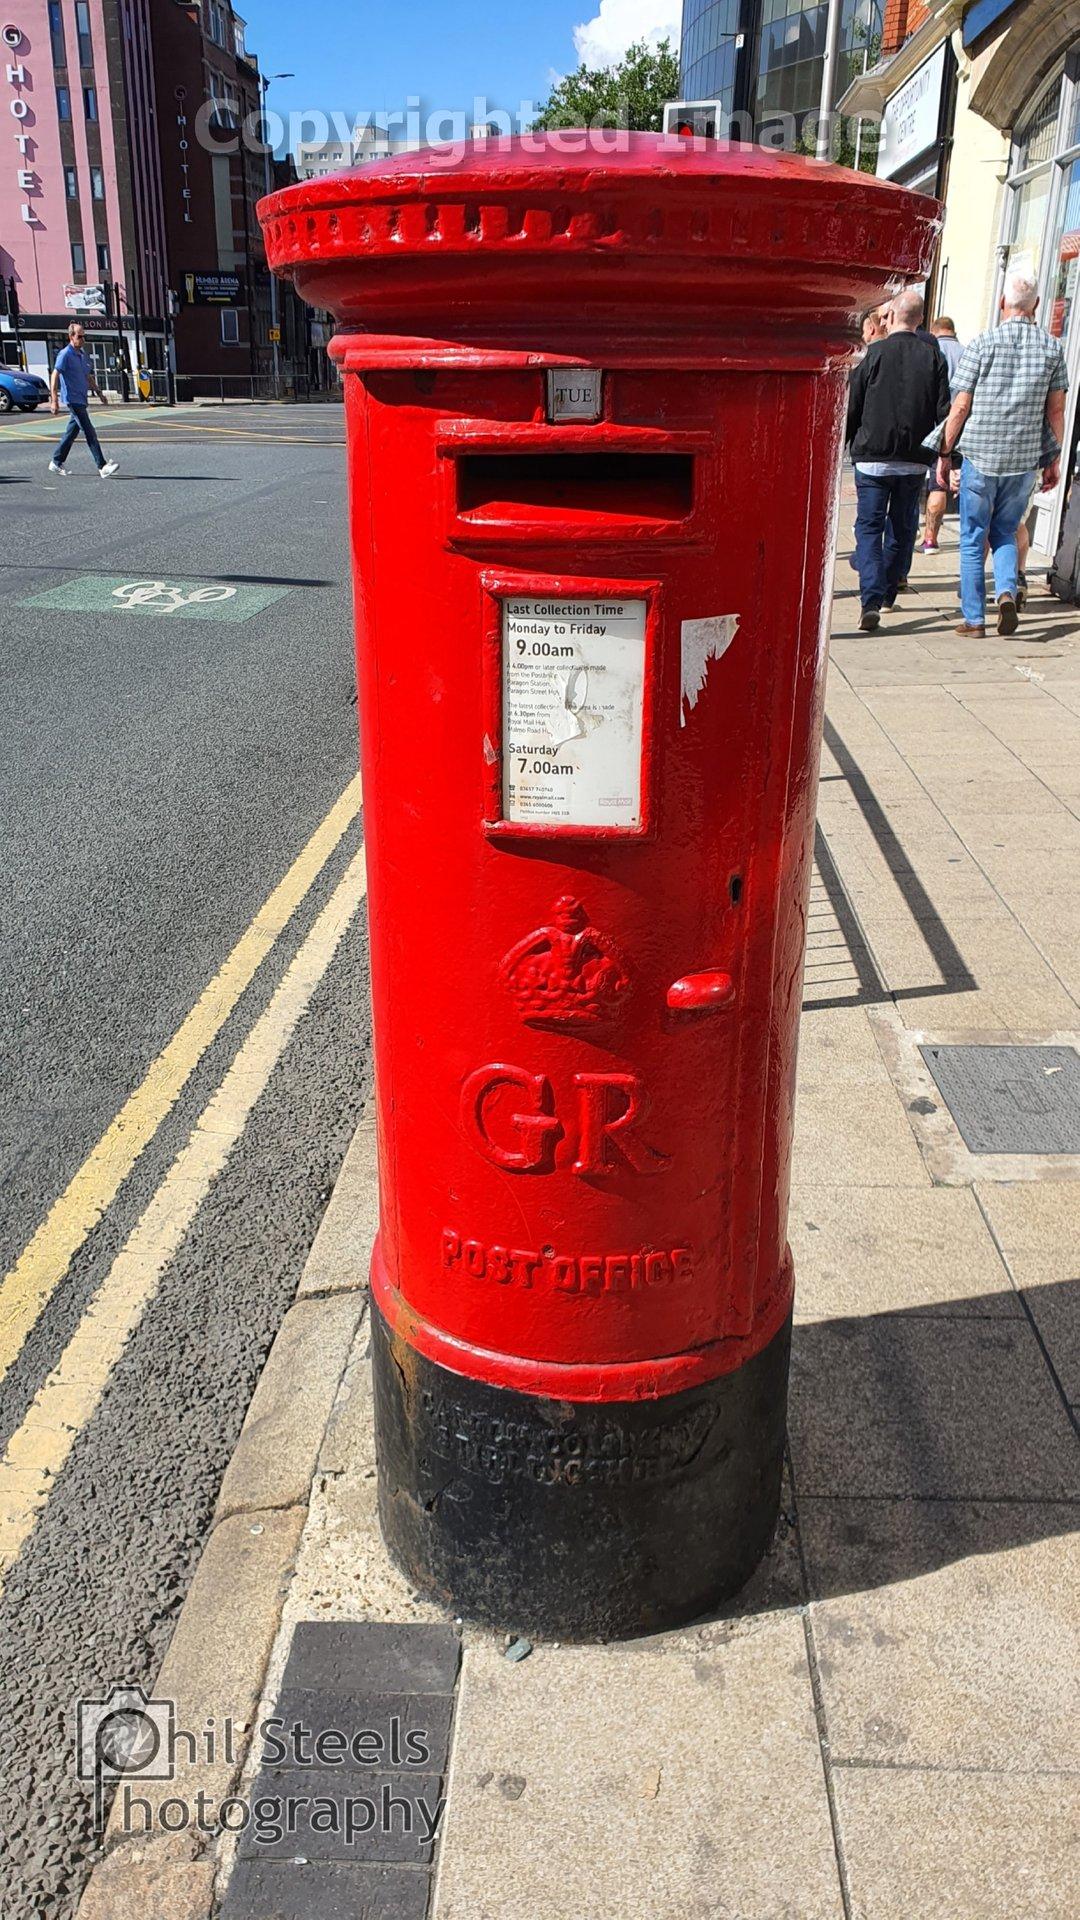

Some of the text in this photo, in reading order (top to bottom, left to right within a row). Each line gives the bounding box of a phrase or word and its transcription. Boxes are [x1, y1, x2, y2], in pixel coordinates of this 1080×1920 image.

[5, 63, 39, 222] HOTEL
[177, 115, 193, 223] HOTEL
[105, 320, 132, 330] HOEL
[556, 388, 592, 403] TUE
[506, 603, 624, 616] Last Collection Time
[507, 622, 607, 637] Monday to Friday
[516, 638, 575, 657] 9.00am
[512, 662, 534, 671] 4.00pm
[508, 743, 559, 757] Saturday
[517, 758, 574, 775] 7.00am
[460, 1062, 673, 1176] GR
[440, 1228, 697, 1294] POST OFFICE
